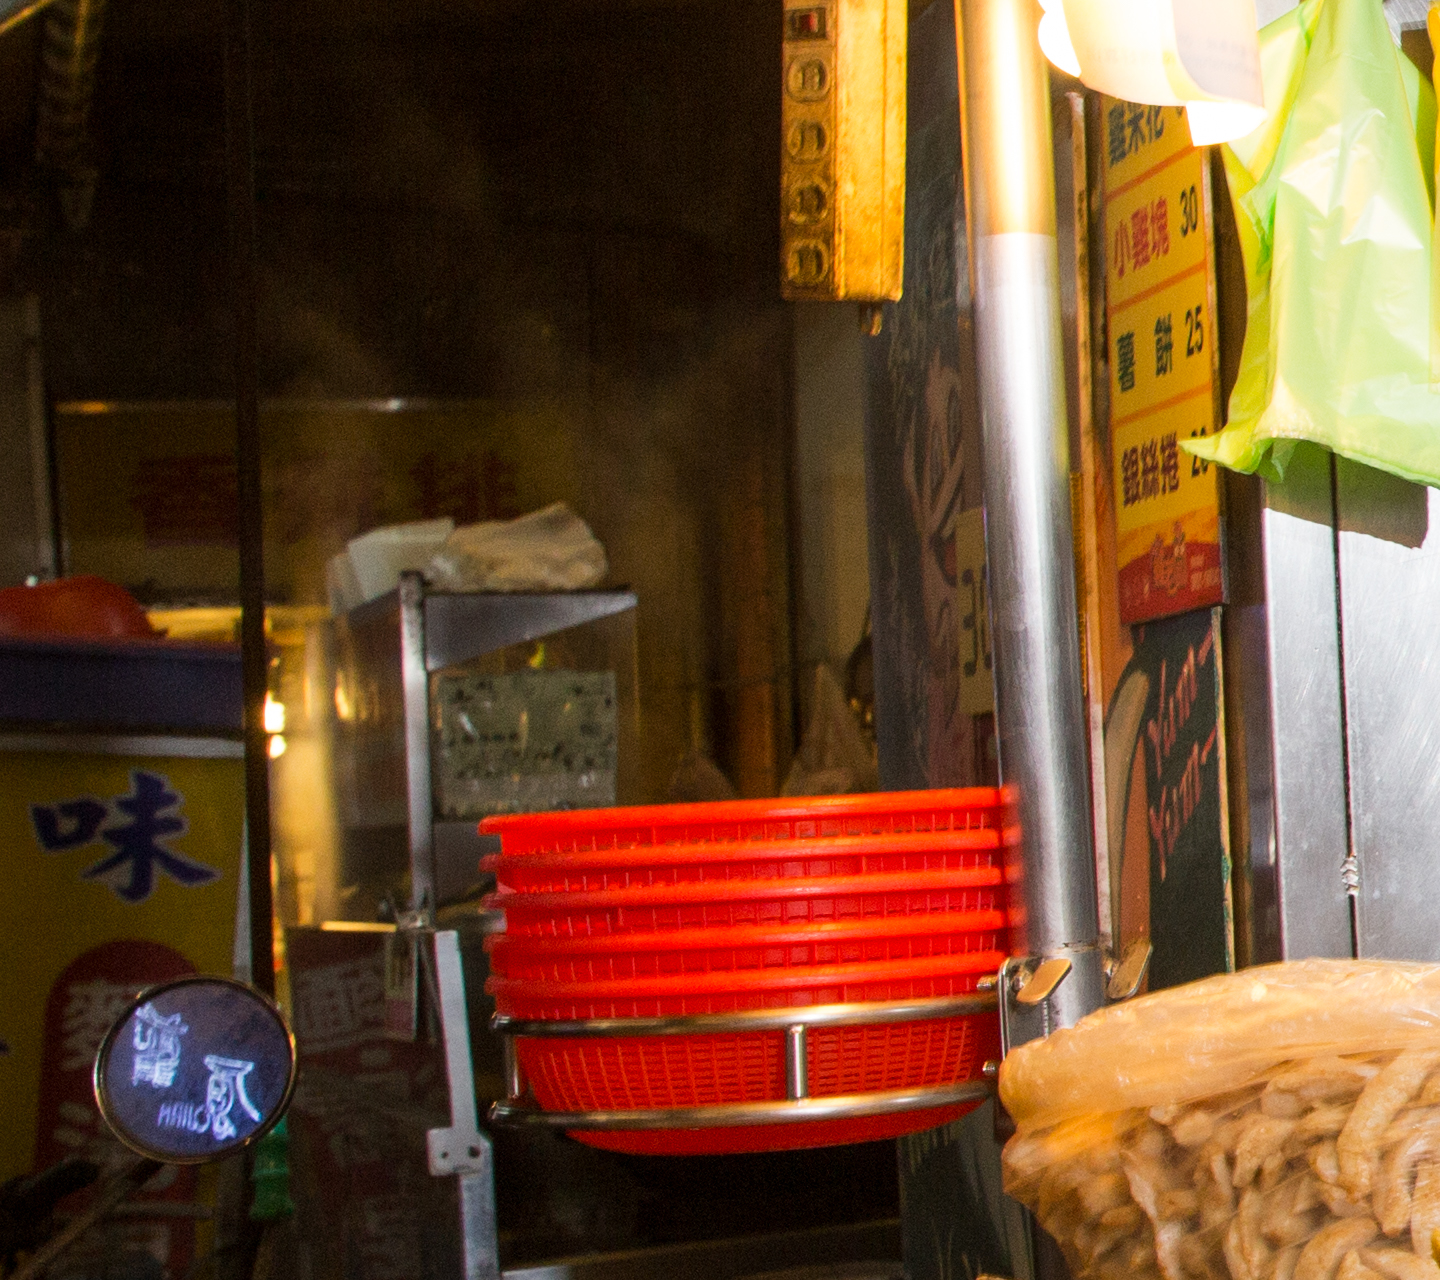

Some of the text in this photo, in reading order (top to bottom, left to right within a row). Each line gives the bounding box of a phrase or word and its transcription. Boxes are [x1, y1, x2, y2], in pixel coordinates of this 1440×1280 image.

[1114, 184, 1198, 281] 小雞塊 30
[1185, 304, 1204, 358] 25
[28, 768, 223, 904] 味
